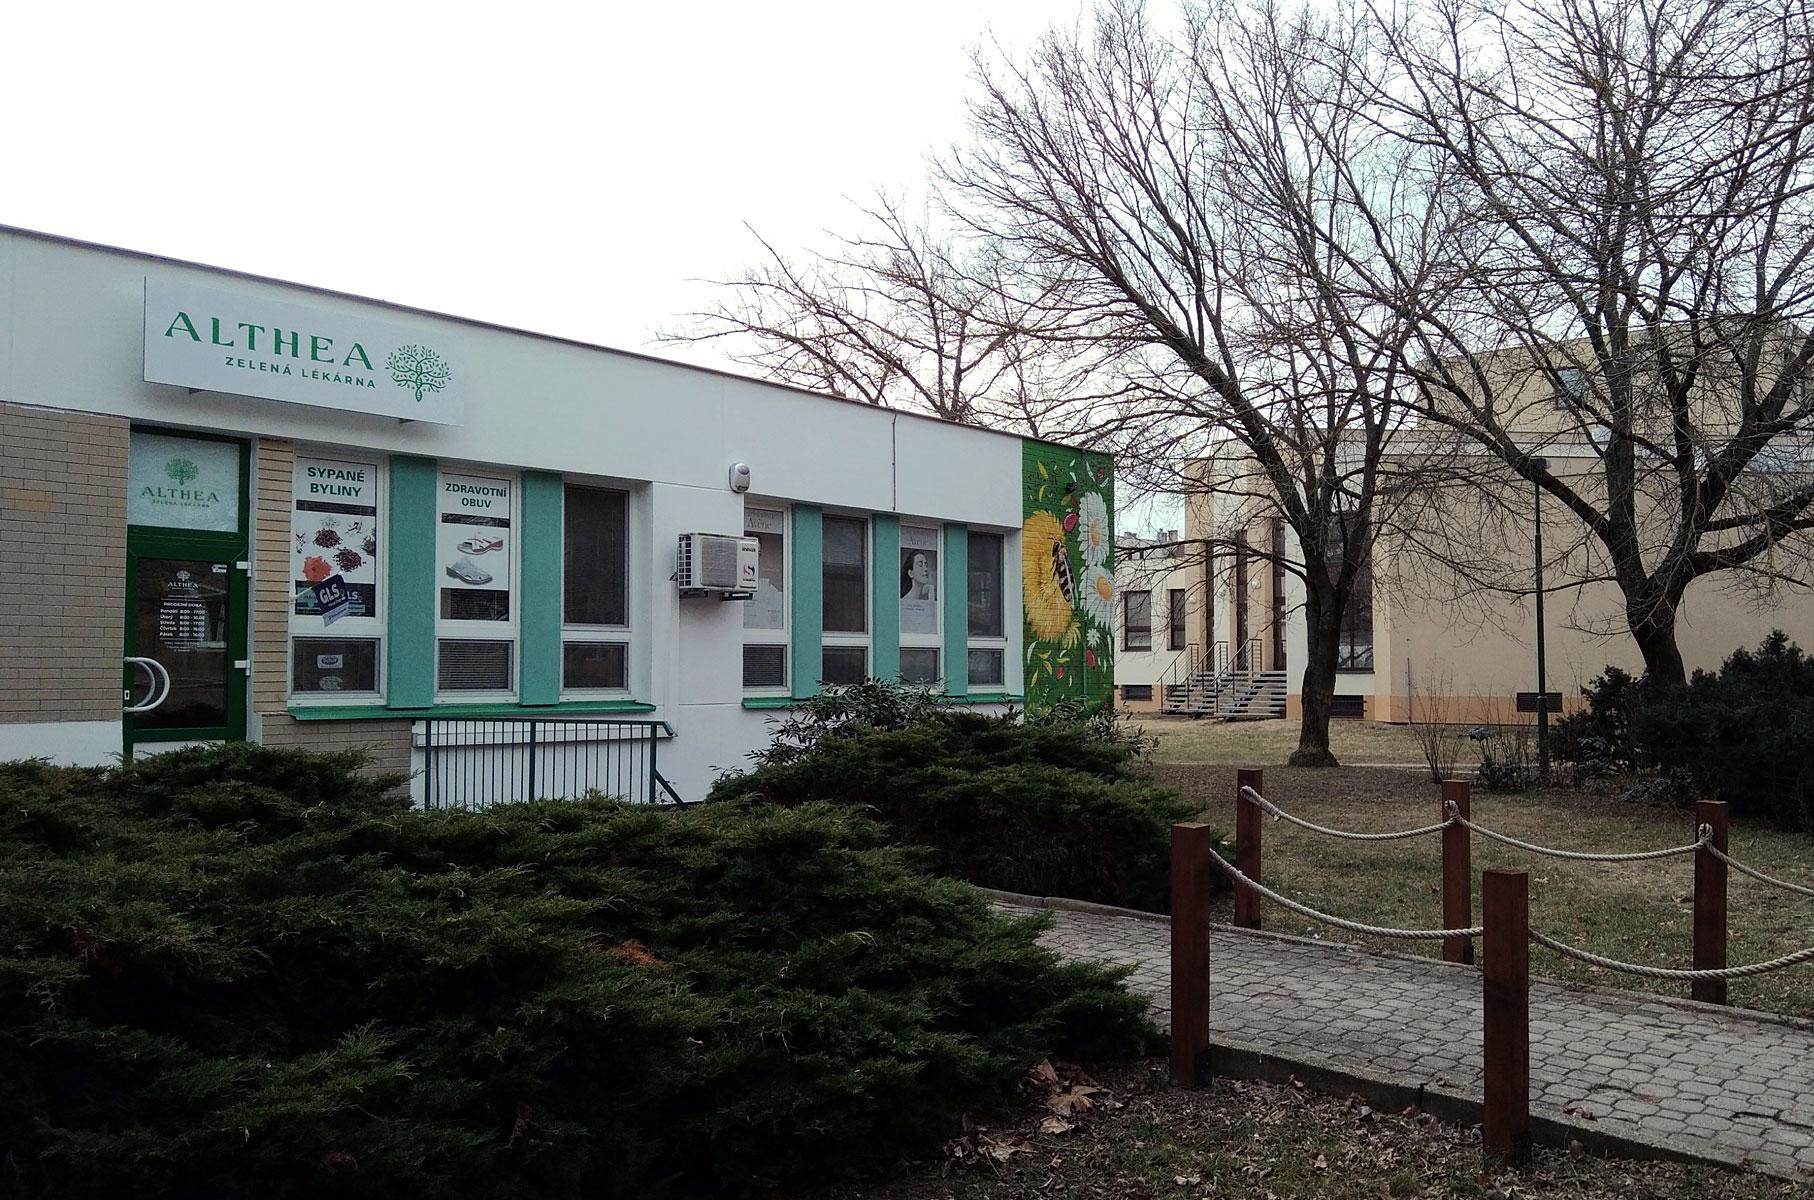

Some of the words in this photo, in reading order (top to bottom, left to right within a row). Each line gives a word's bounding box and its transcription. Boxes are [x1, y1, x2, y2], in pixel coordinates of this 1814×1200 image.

[164, 311, 374, 371] ALTHEA
[225, 356, 292, 376] ZELENÁ
[301, 367, 376, 389] LÉKÁRNA
[307, 466, 365, 482] SYPANÉ
[141, 486, 219, 503] ALTHEA
[310, 483, 361, 497] BYLINY
[445, 482, 507, 498] ZDRAVOTNÍ
[461, 497, 492, 508] OBUV
[319, 583, 340, 604] GLS
